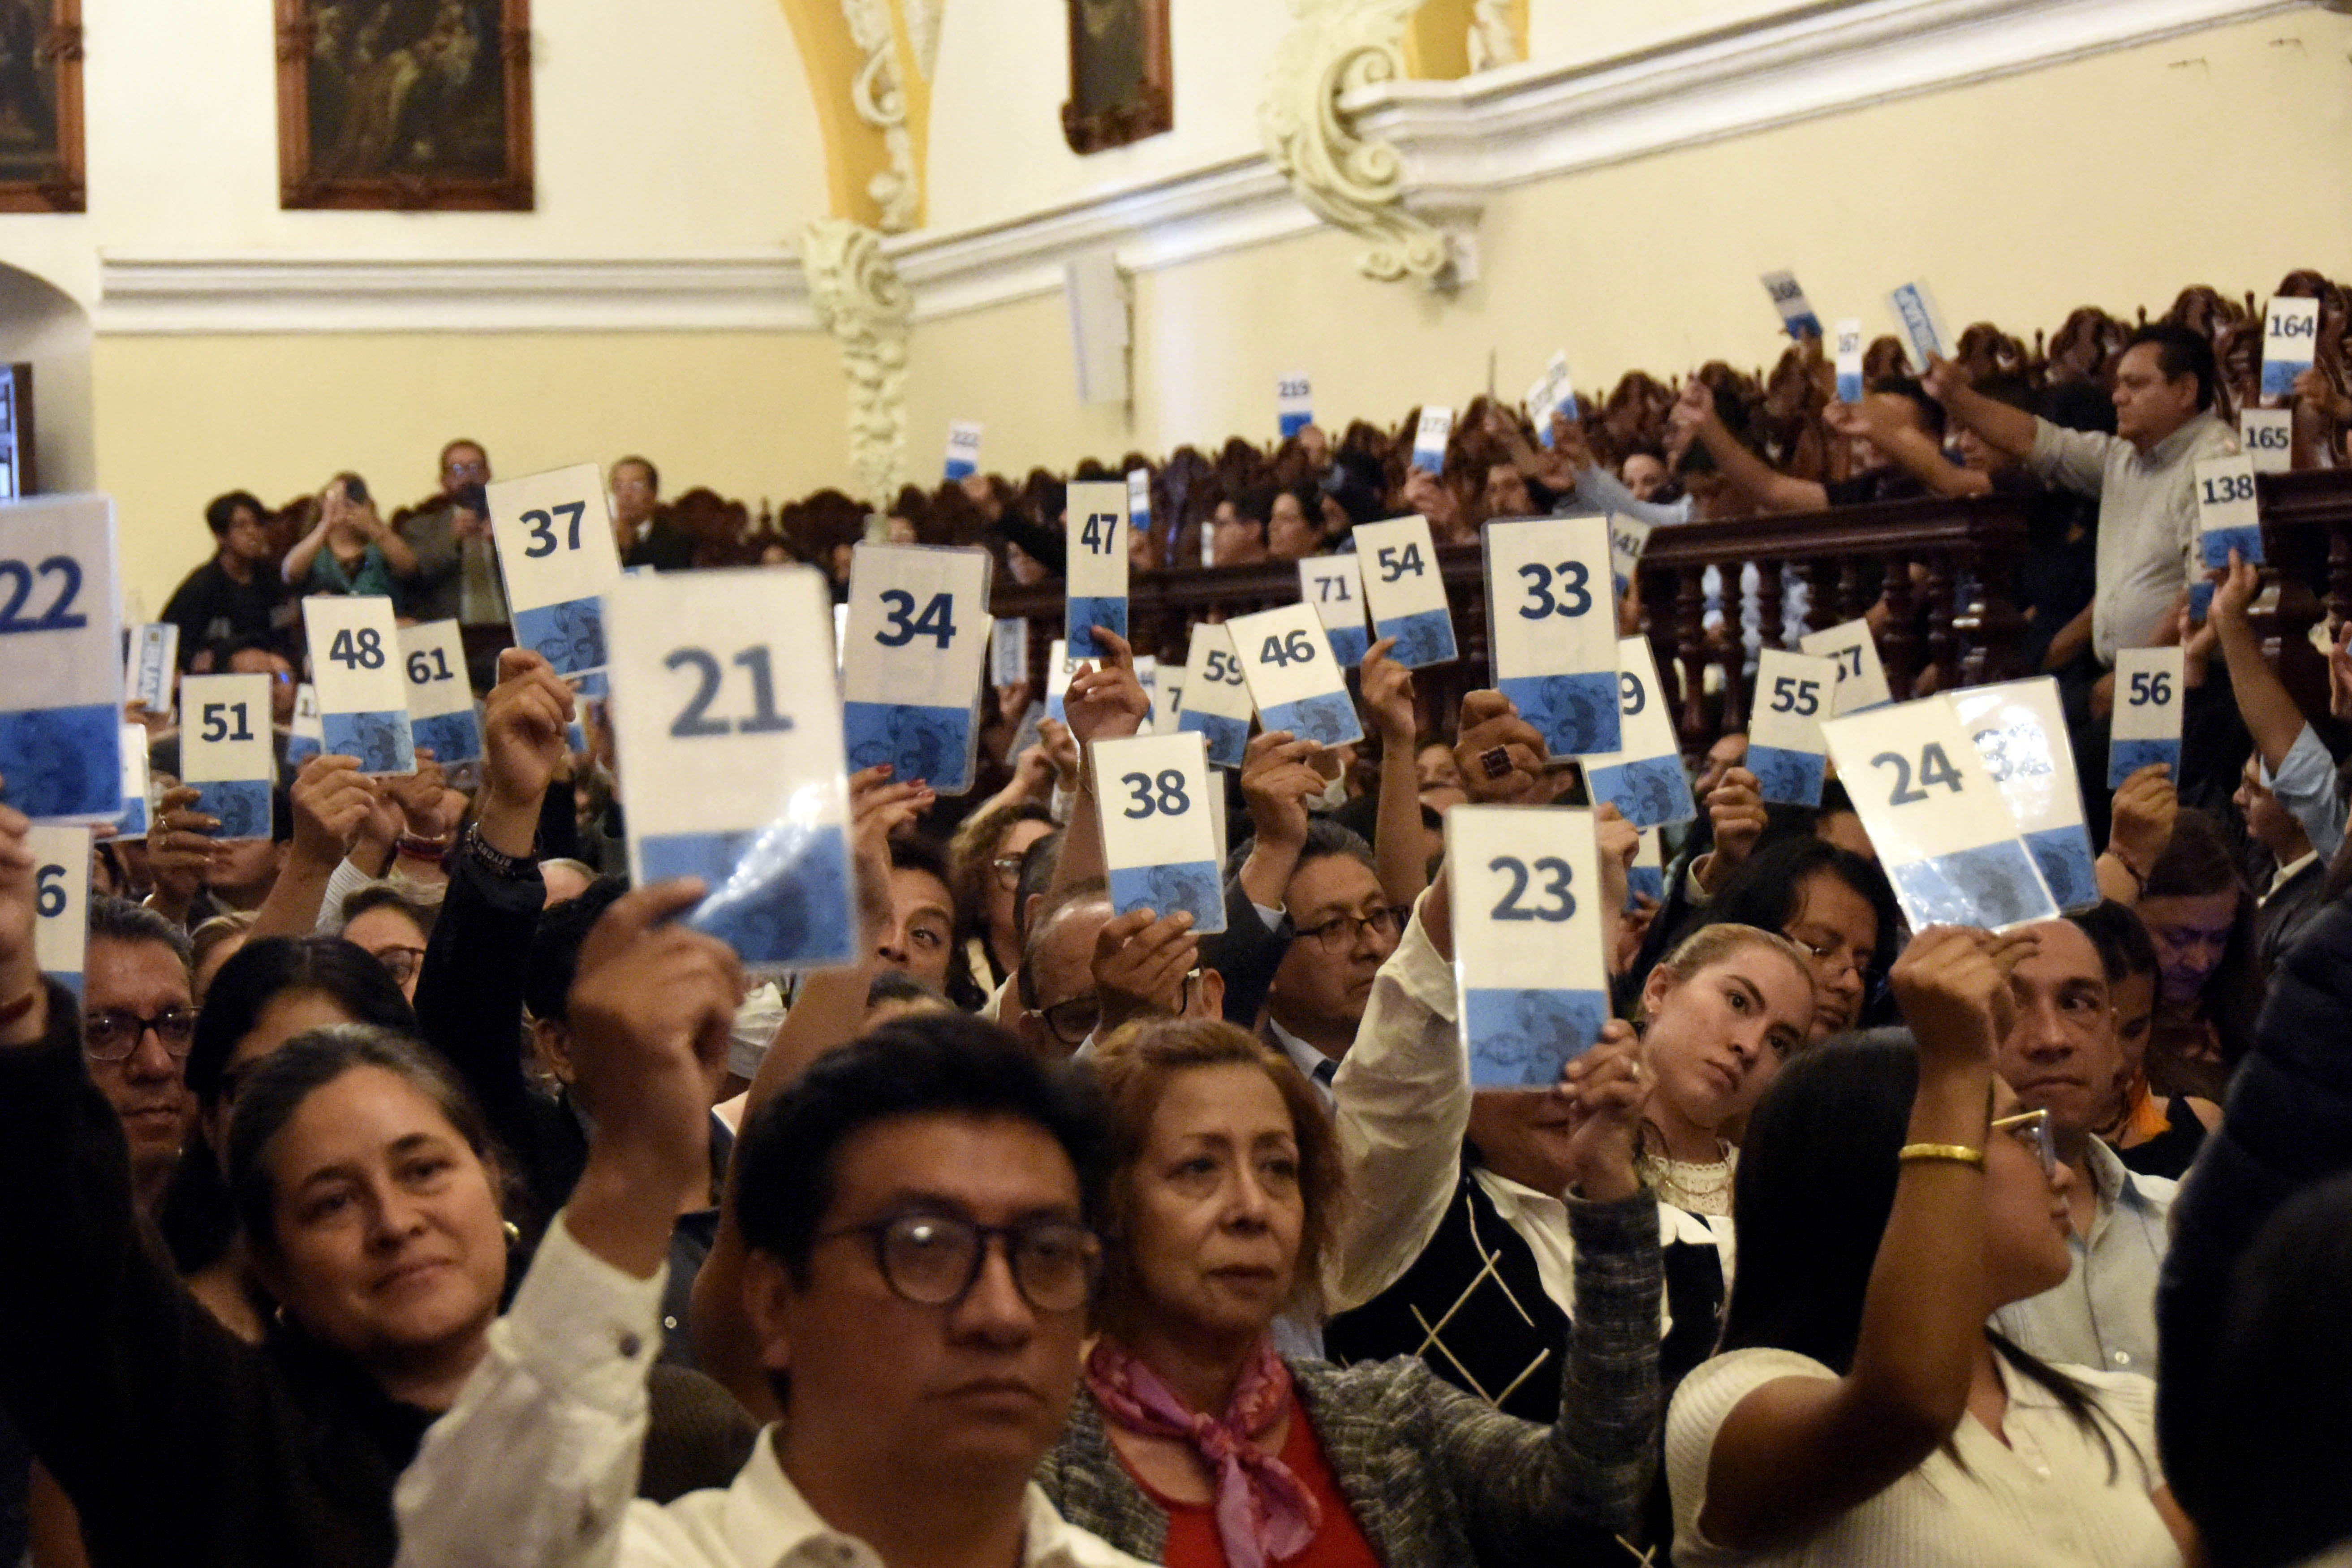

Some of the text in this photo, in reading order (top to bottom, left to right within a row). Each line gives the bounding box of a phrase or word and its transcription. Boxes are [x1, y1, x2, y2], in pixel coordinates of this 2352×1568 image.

[2270, 314, 2313, 338] 164
[2246, 426, 2289, 449] 165
[2203, 474, 2255, 505] 138
[519, 500, 586, 559] 37
[1081, 513, 1118, 555] 47
[1377, 543, 1425, 582] 54
[0, 556, 87, 635] 22
[1314, 575, 1351, 603] 71
[1517, 560, 1592, 620] 33
[874, 589, 957, 649] 34
[329, 628, 385, 670] 48
[406, 647, 454, 685] 61
[1203, 650, 1244, 686] 59
[1260, 629, 1315, 668] 46
[663, 645, 794, 739] 21
[1770, 676, 1820, 716] 55
[2129, 672, 2172, 706] 56
[201, 702, 254, 742] 51
[1121, 769, 1190, 819] 38
[1871, 742, 1964, 806] 24
[1488, 856, 1577, 923] 23
